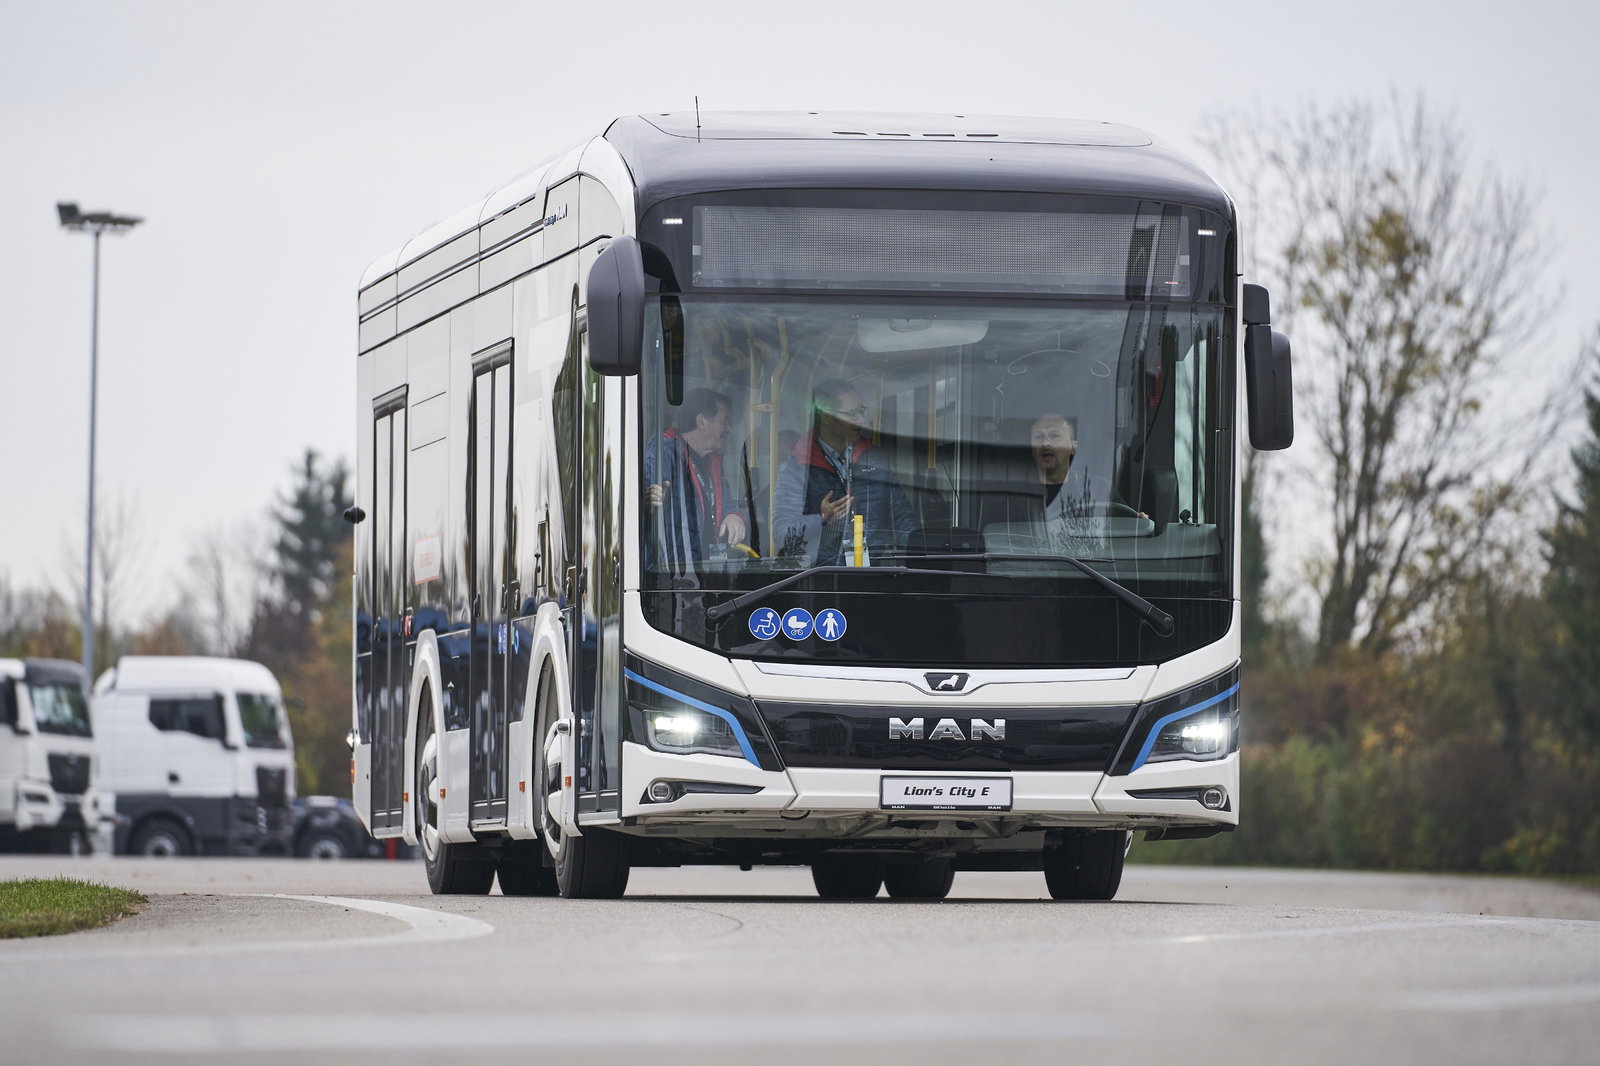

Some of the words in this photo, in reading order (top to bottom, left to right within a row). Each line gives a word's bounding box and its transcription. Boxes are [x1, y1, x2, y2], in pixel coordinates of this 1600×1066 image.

[889, 717, 1006, 740] MAN
[904, 786, 943, 796] Lion's
[949, 786, 976, 798] City
[981, 786, 990, 796] E
